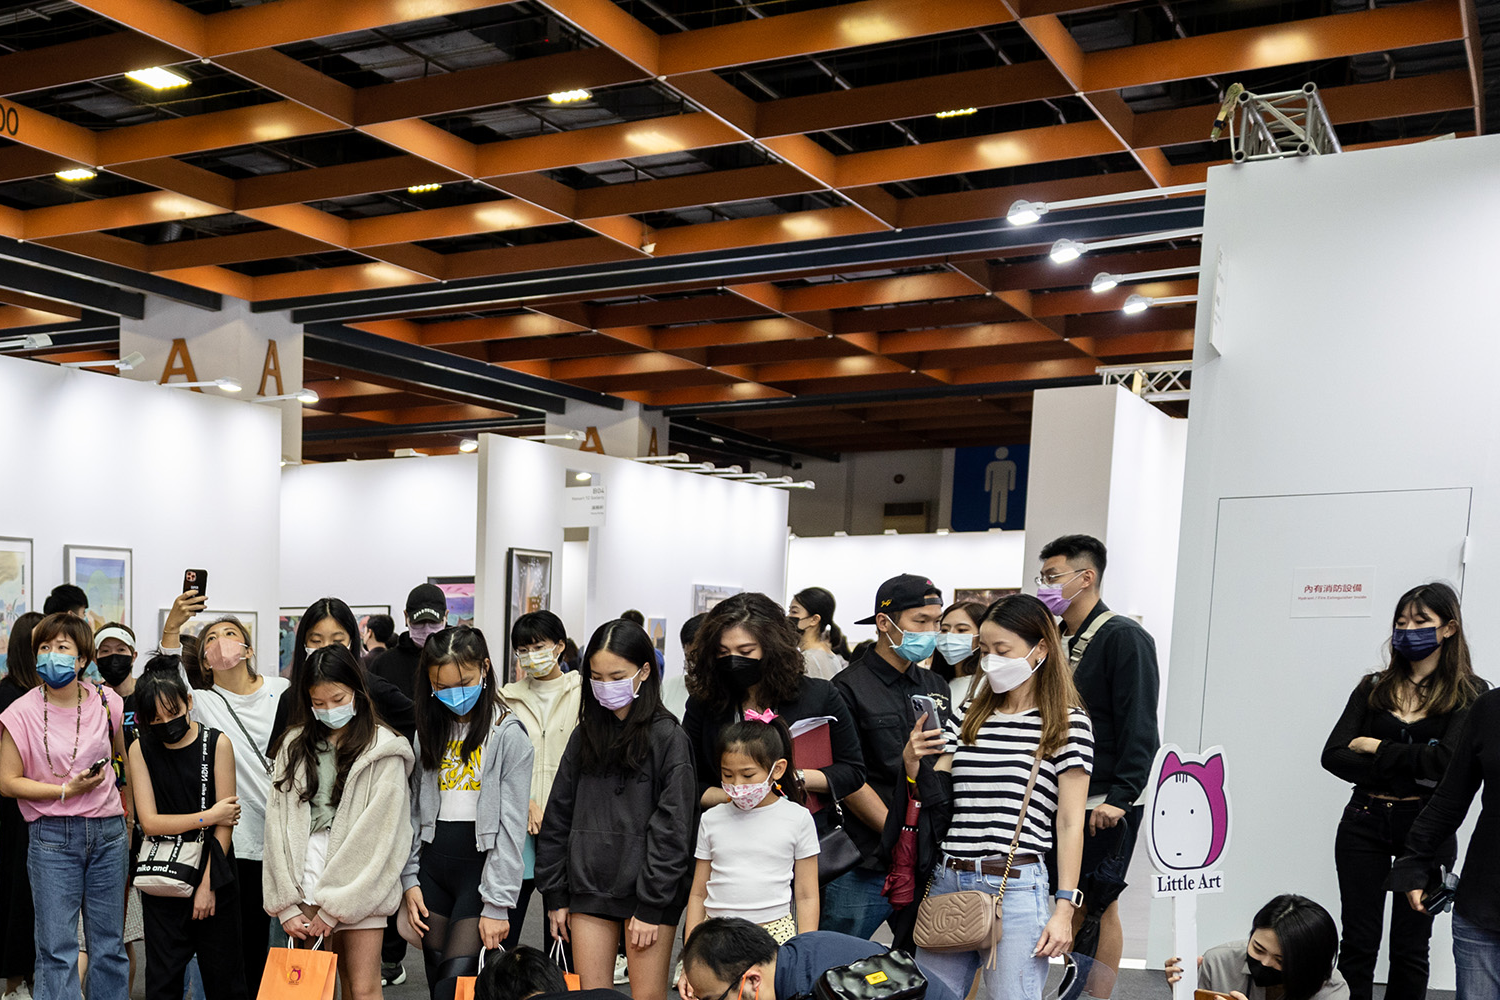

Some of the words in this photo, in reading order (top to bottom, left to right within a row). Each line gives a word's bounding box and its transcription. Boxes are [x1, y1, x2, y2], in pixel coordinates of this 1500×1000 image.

[159, 338, 204, 393] A
[257, 339, 285, 400] A
[579, 426, 605, 455] A
[647, 426, 659, 459] A
[1157, 874, 1195, 892] Little
[1198, 873, 1221, 890] Art
